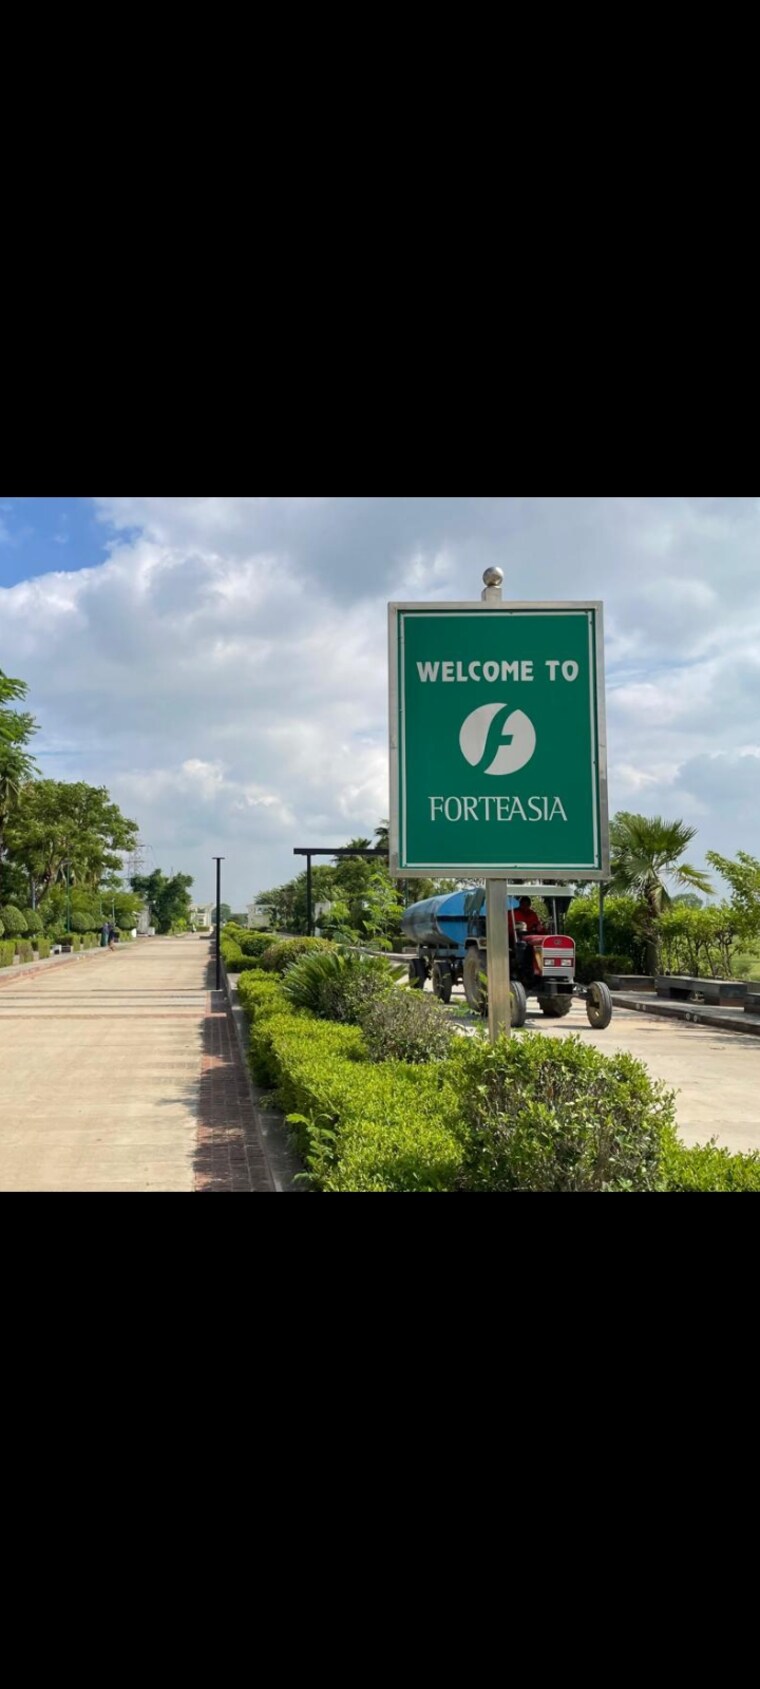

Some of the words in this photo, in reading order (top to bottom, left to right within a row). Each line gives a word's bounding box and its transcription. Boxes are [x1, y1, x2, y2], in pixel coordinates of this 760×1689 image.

[416, 661, 534, 682] WELCOME
[545, 660, 579, 682] TO
[428, 796, 568, 822] FORTEASIA
